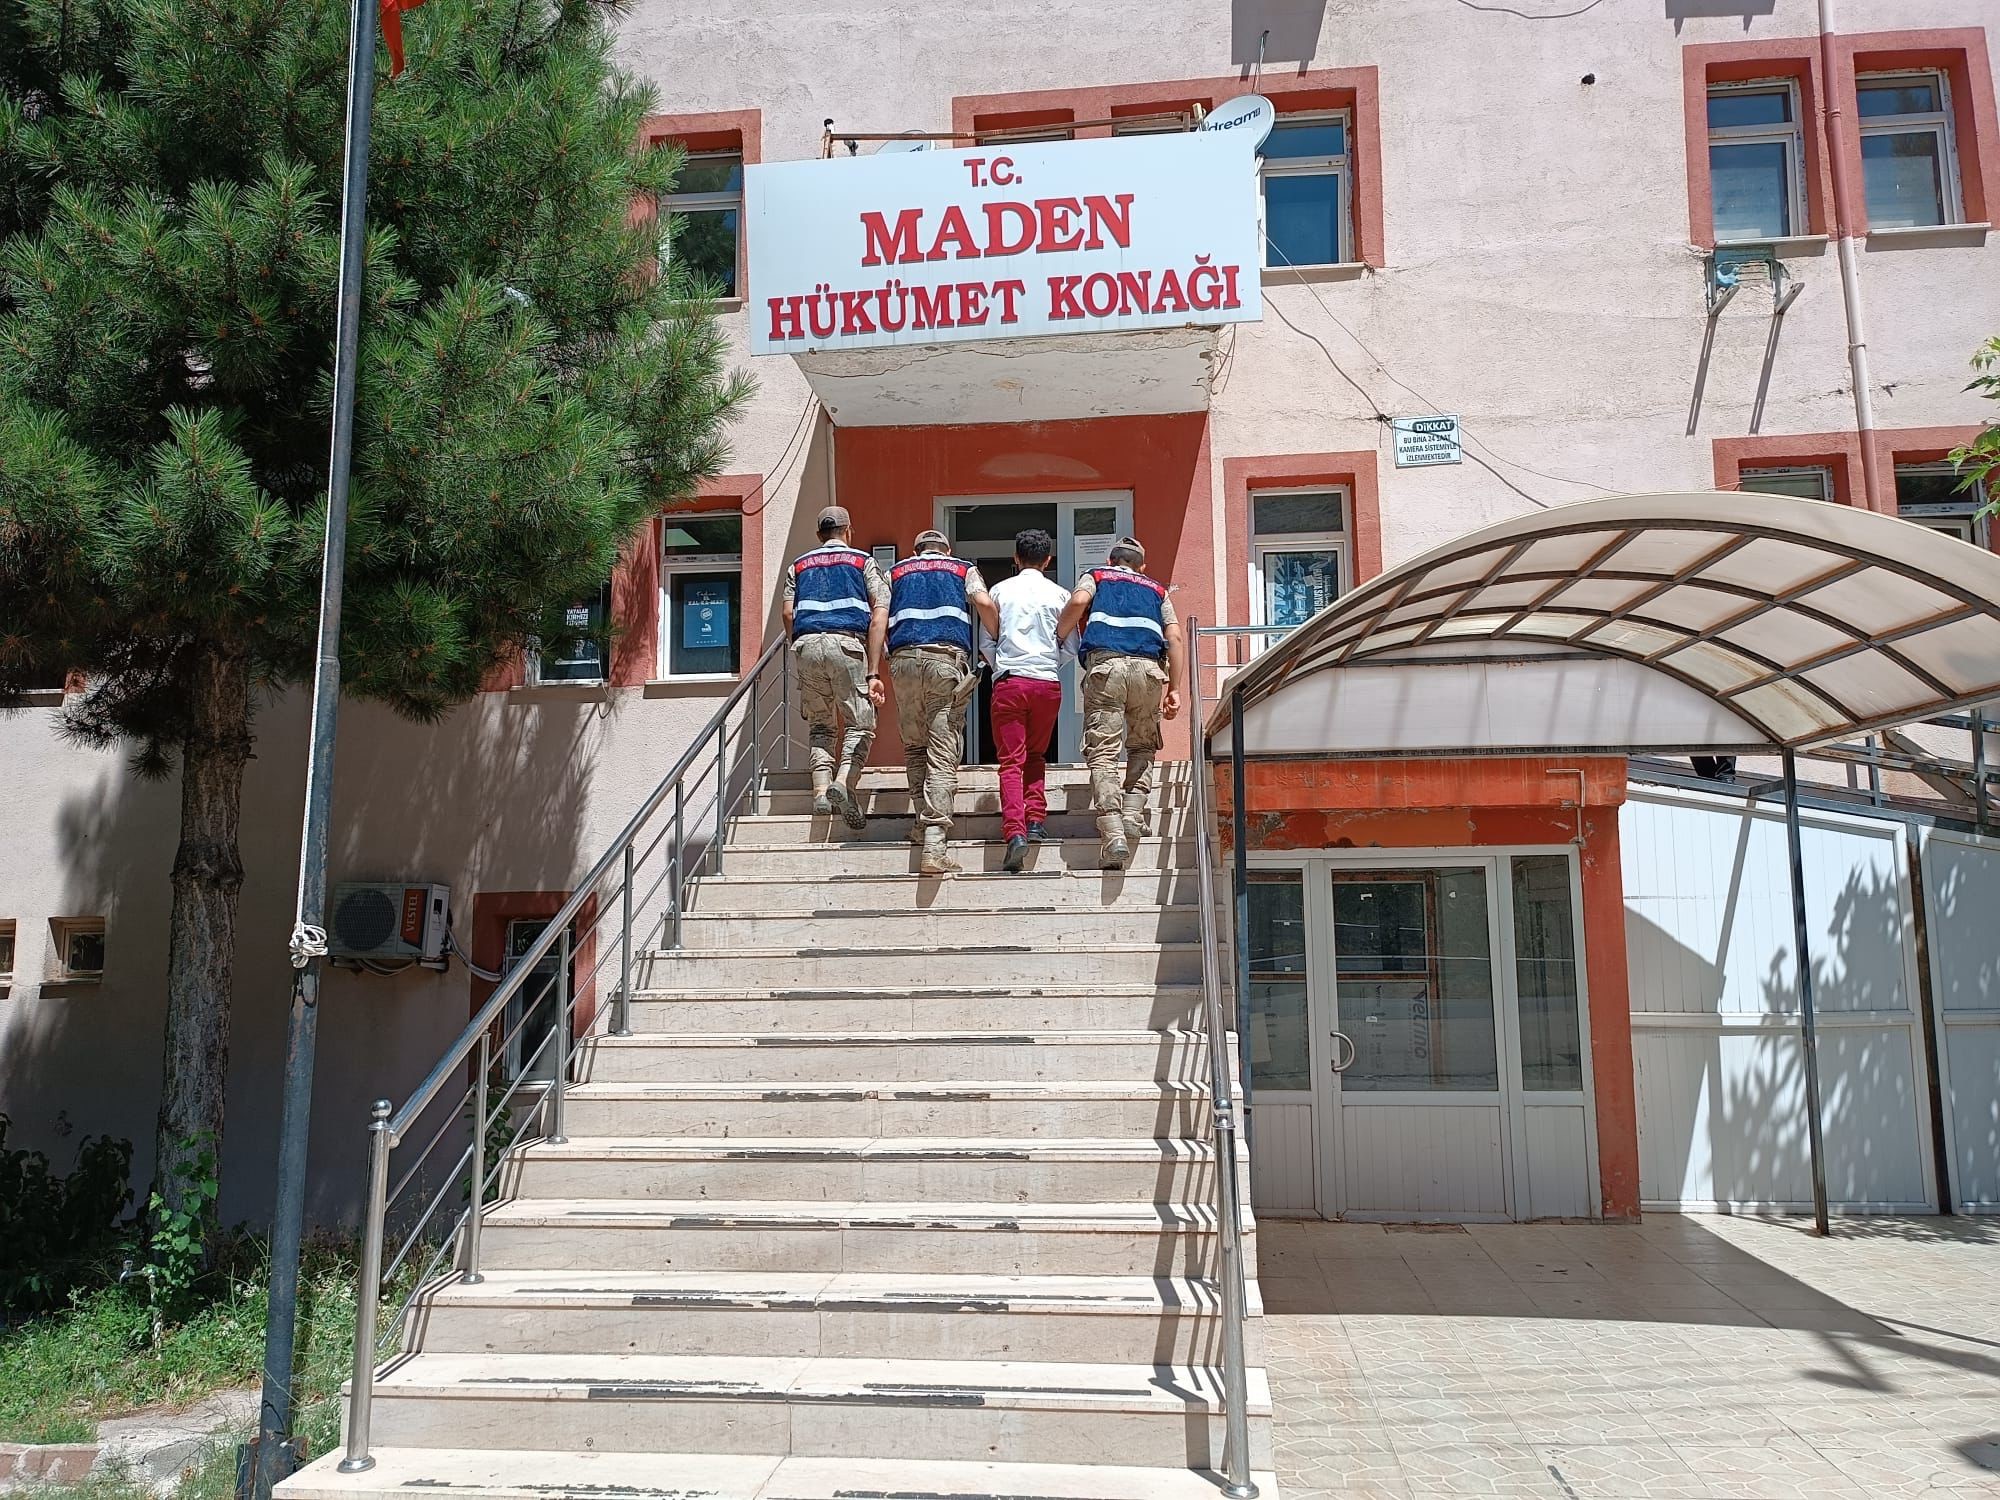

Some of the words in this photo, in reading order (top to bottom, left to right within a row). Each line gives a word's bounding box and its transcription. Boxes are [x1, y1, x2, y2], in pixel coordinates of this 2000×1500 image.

[963, 156, 1023, 188] T.C.
[860, 193, 1135, 267] MADEN
[767, 279, 1026, 342] HÜKÜMET
[1047, 252, 1242, 321] KONAĞI
[1399, 446, 1424, 454] KAMERA
[406, 894, 418, 932] VESTEL
